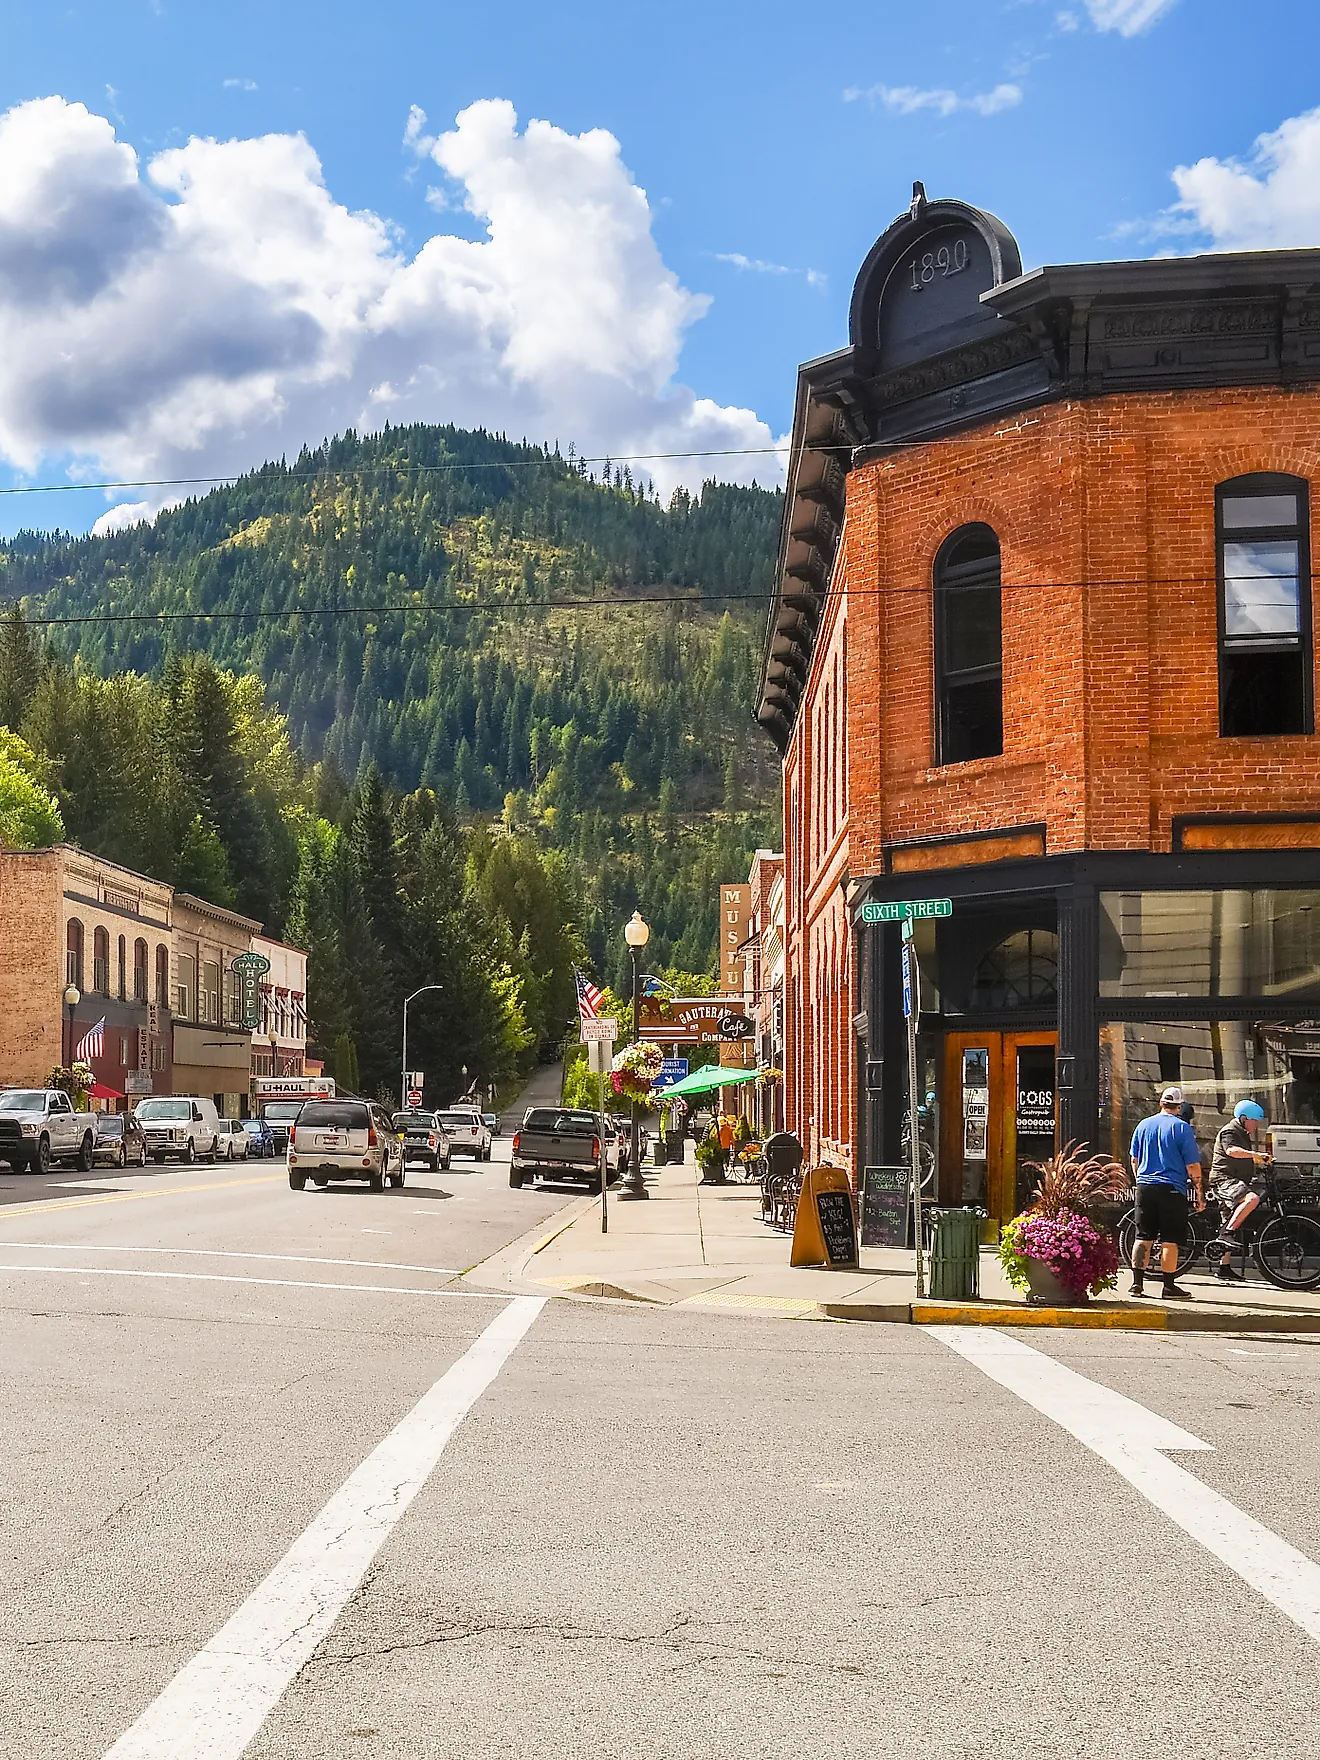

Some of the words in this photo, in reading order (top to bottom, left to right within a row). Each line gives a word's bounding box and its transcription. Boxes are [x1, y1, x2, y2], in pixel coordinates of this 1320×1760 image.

[908, 239, 969, 290] 1890
[865, 904, 899, 920] SIXTH
[905, 901, 949, 917] STREET
[724, 890, 741, 999] MUSEU
[246, 969, 255, 1018] HOTEL
[149, 1004, 157, 1032] REAL
[140, 1029, 148, 1070] ESTATE
[262, 1084, 306, 1092] U-HAUL
[968, 1105, 986, 1115] OPEN
